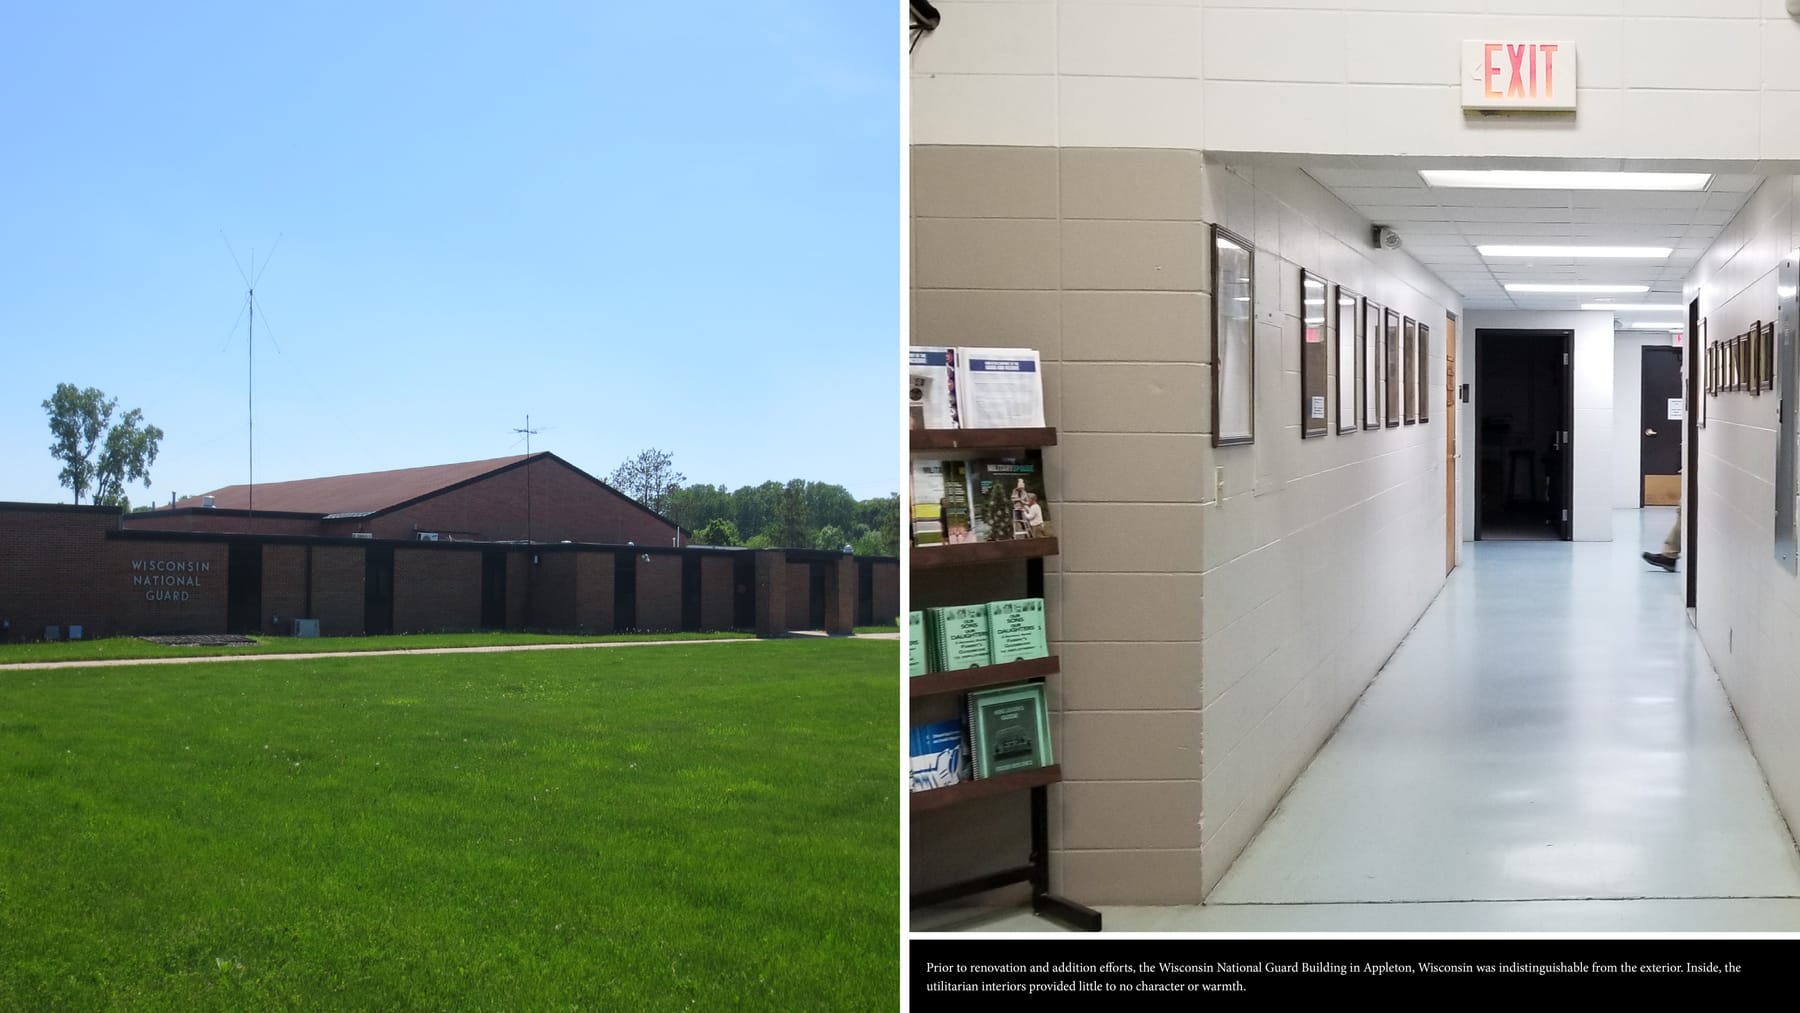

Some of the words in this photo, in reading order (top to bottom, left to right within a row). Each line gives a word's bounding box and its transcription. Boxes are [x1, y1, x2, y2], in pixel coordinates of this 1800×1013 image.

[1484, 43, 1559, 98] EXIT
[131, 560, 210, 572] WISCONSIN
[133, 575, 201, 587] NATIONAL
[145, 590, 189, 601] GUARD
[960, 622, 978, 630] SONS
[997, 625, 1035, 635] DAUGHTERS
